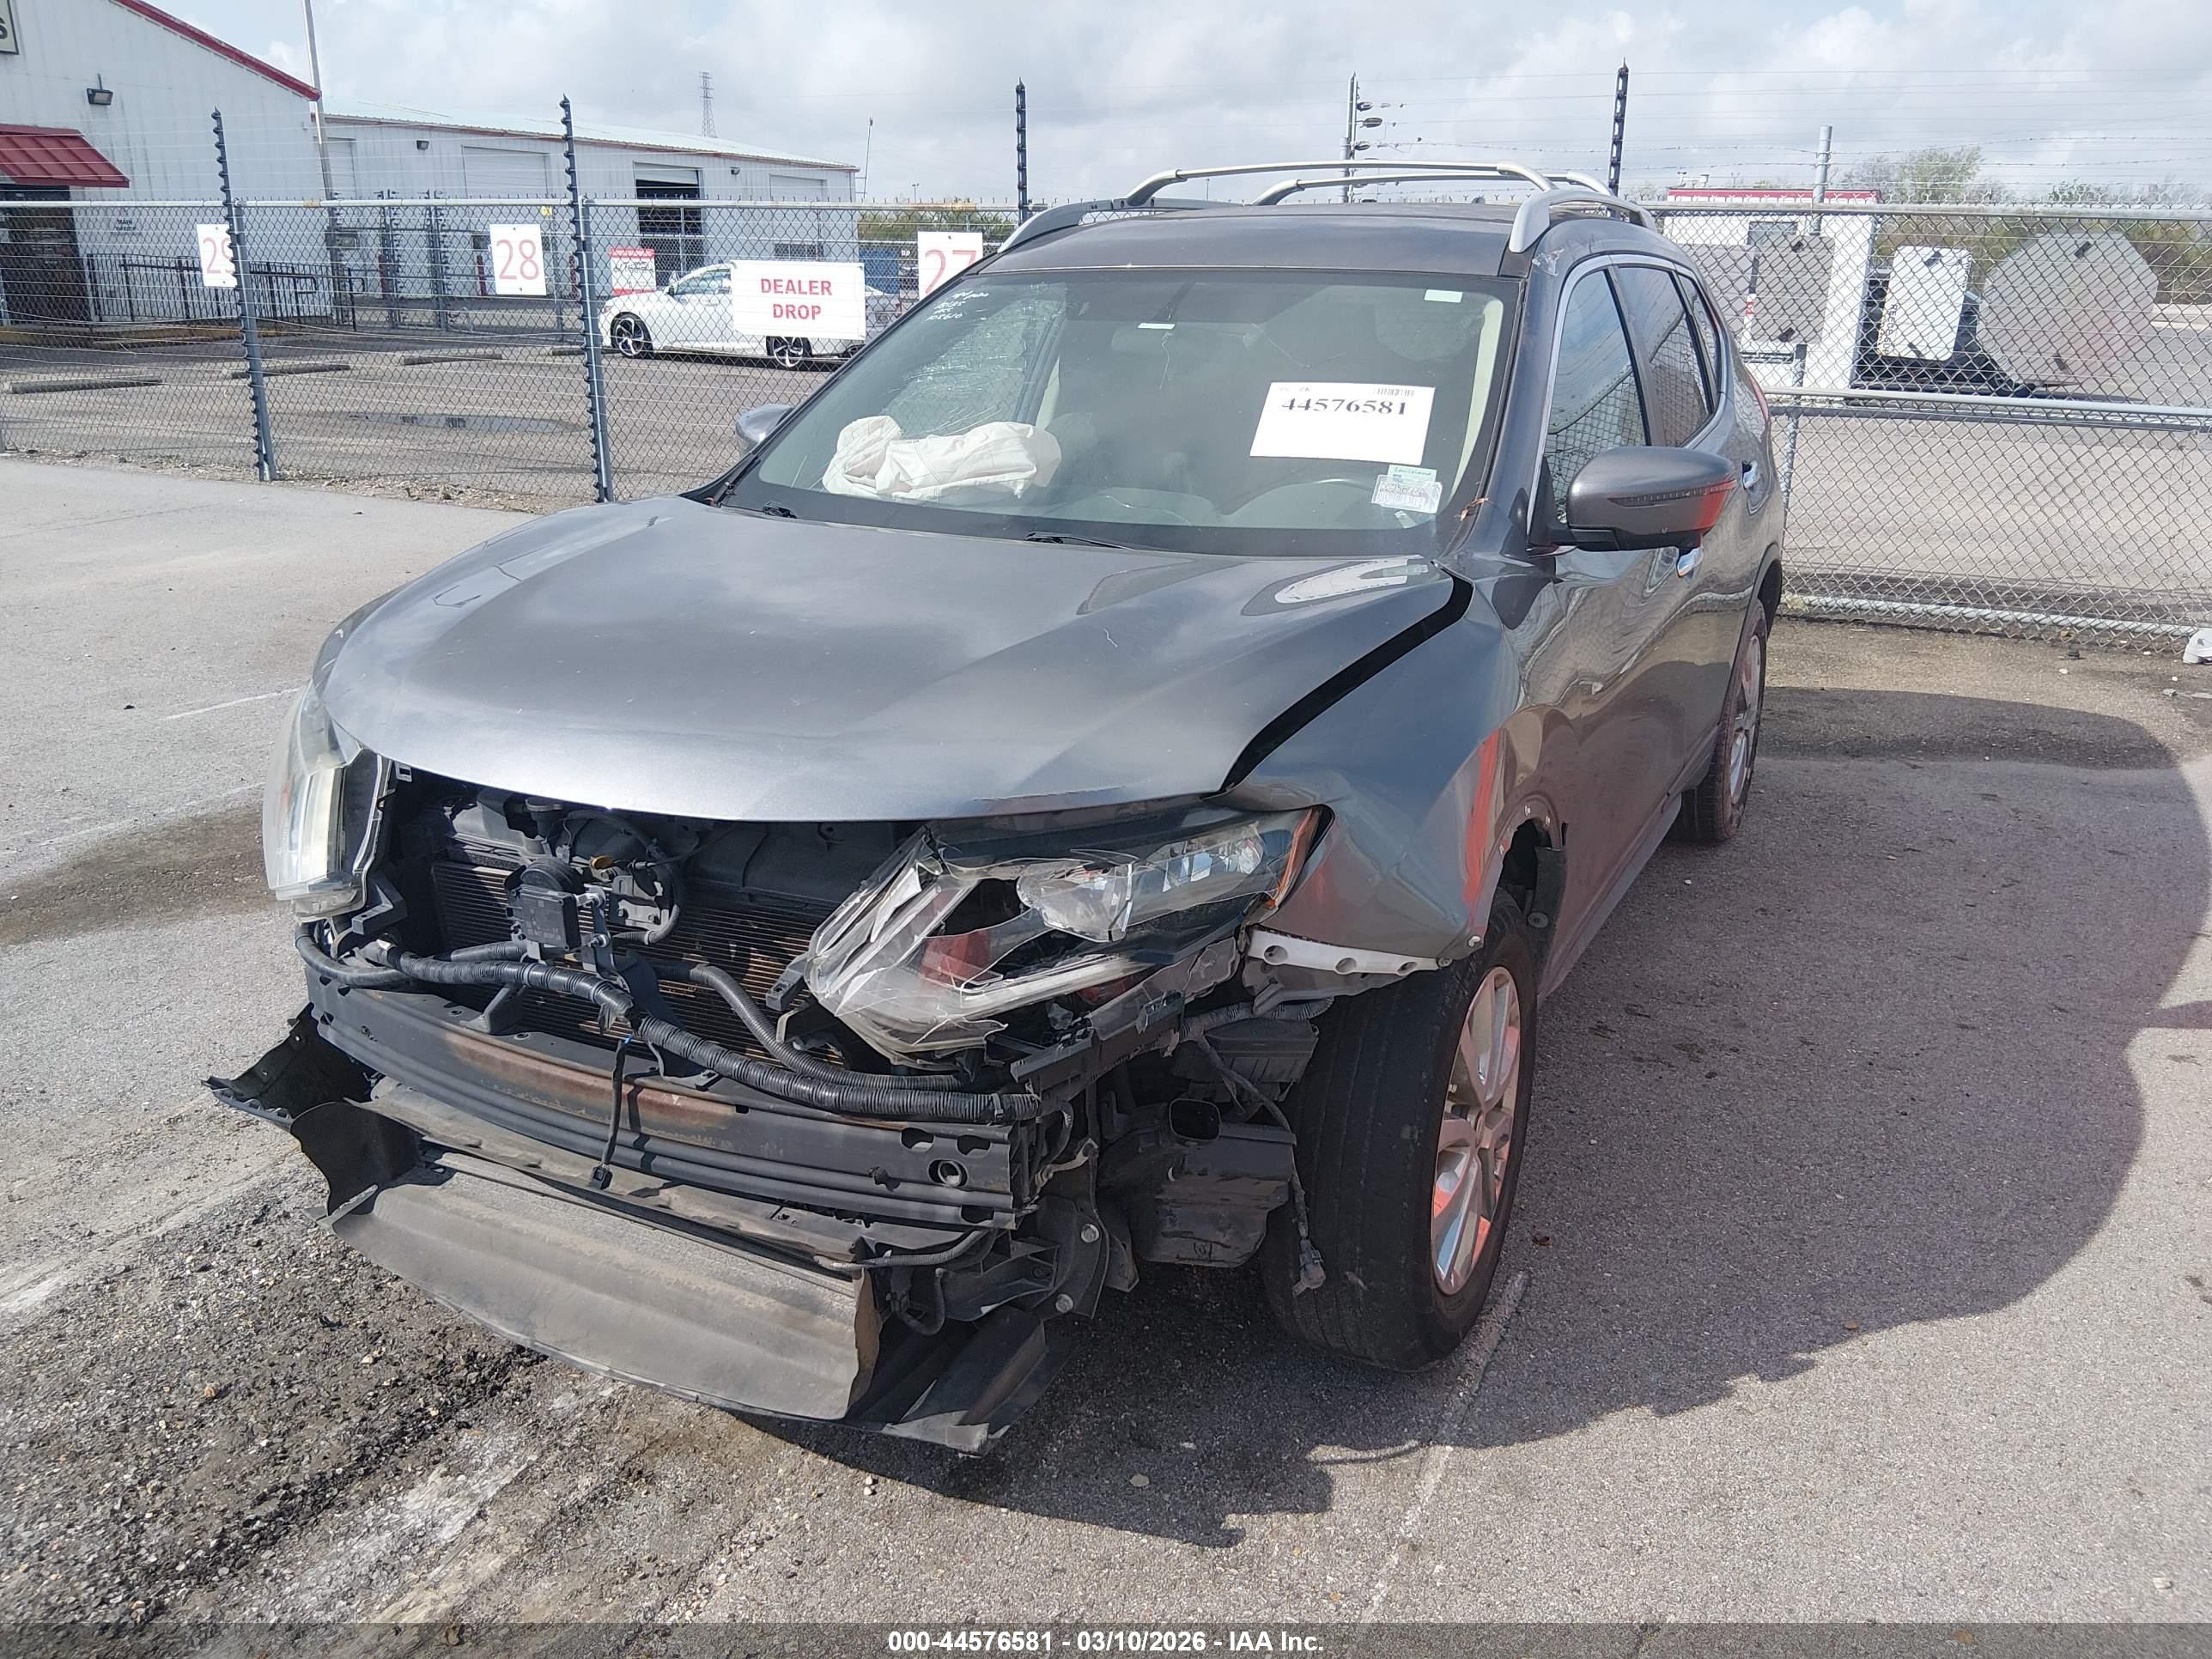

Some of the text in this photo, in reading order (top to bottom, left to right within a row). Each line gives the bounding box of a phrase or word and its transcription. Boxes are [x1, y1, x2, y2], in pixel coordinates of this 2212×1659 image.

[495, 239, 540, 281] 28
[760, 277, 833, 296] DEALER
[772, 303, 822, 320] DROP
[1281, 398, 1407, 416] 44576581
